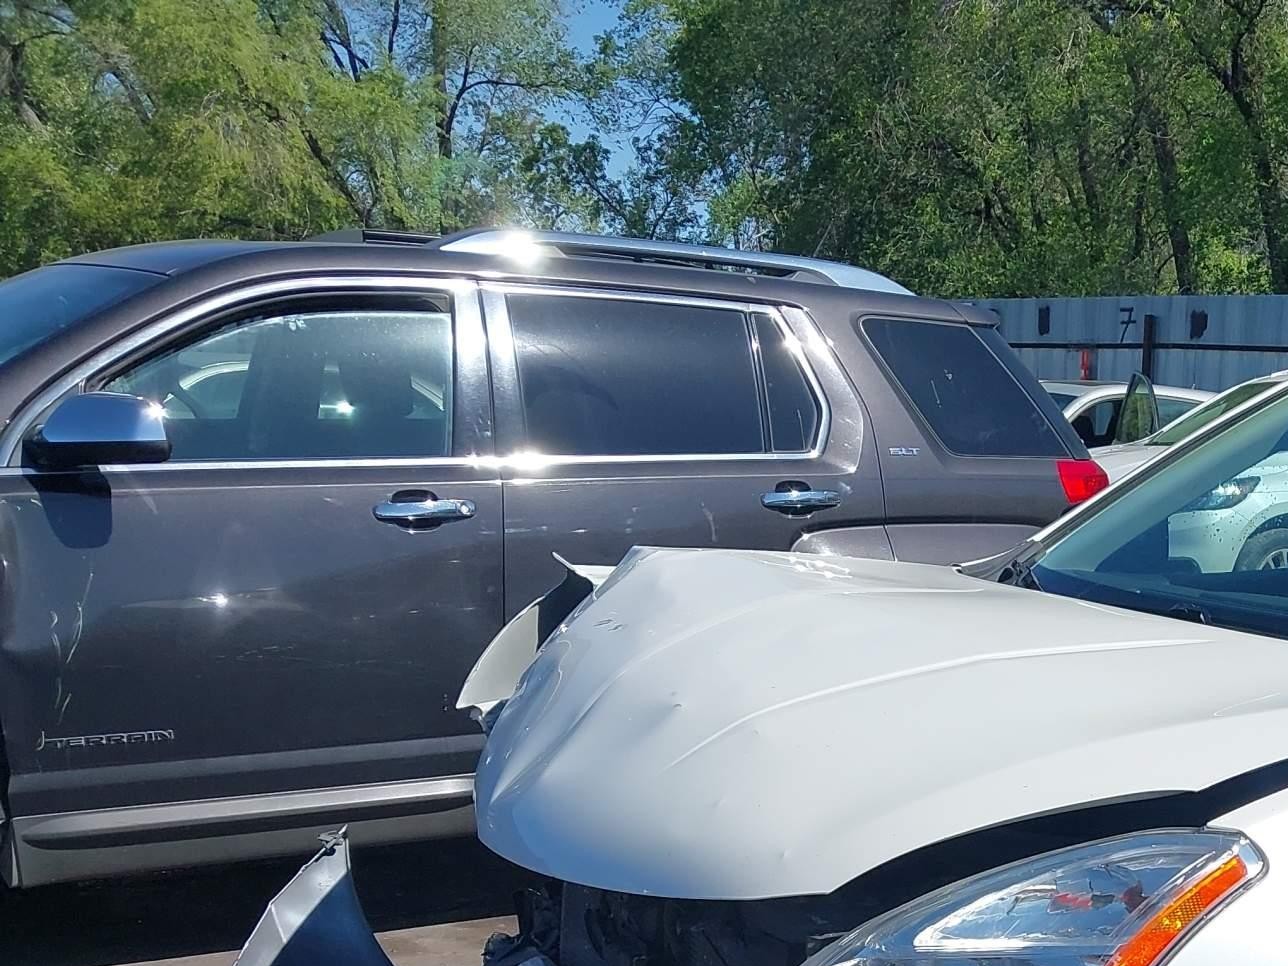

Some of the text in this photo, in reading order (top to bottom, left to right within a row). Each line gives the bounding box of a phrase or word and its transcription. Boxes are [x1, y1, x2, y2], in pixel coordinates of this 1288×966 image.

[1119, 306, 1137, 343] 7
[888, 446, 921, 456] SLT
[36, 730, 176, 751] TERRAIN
